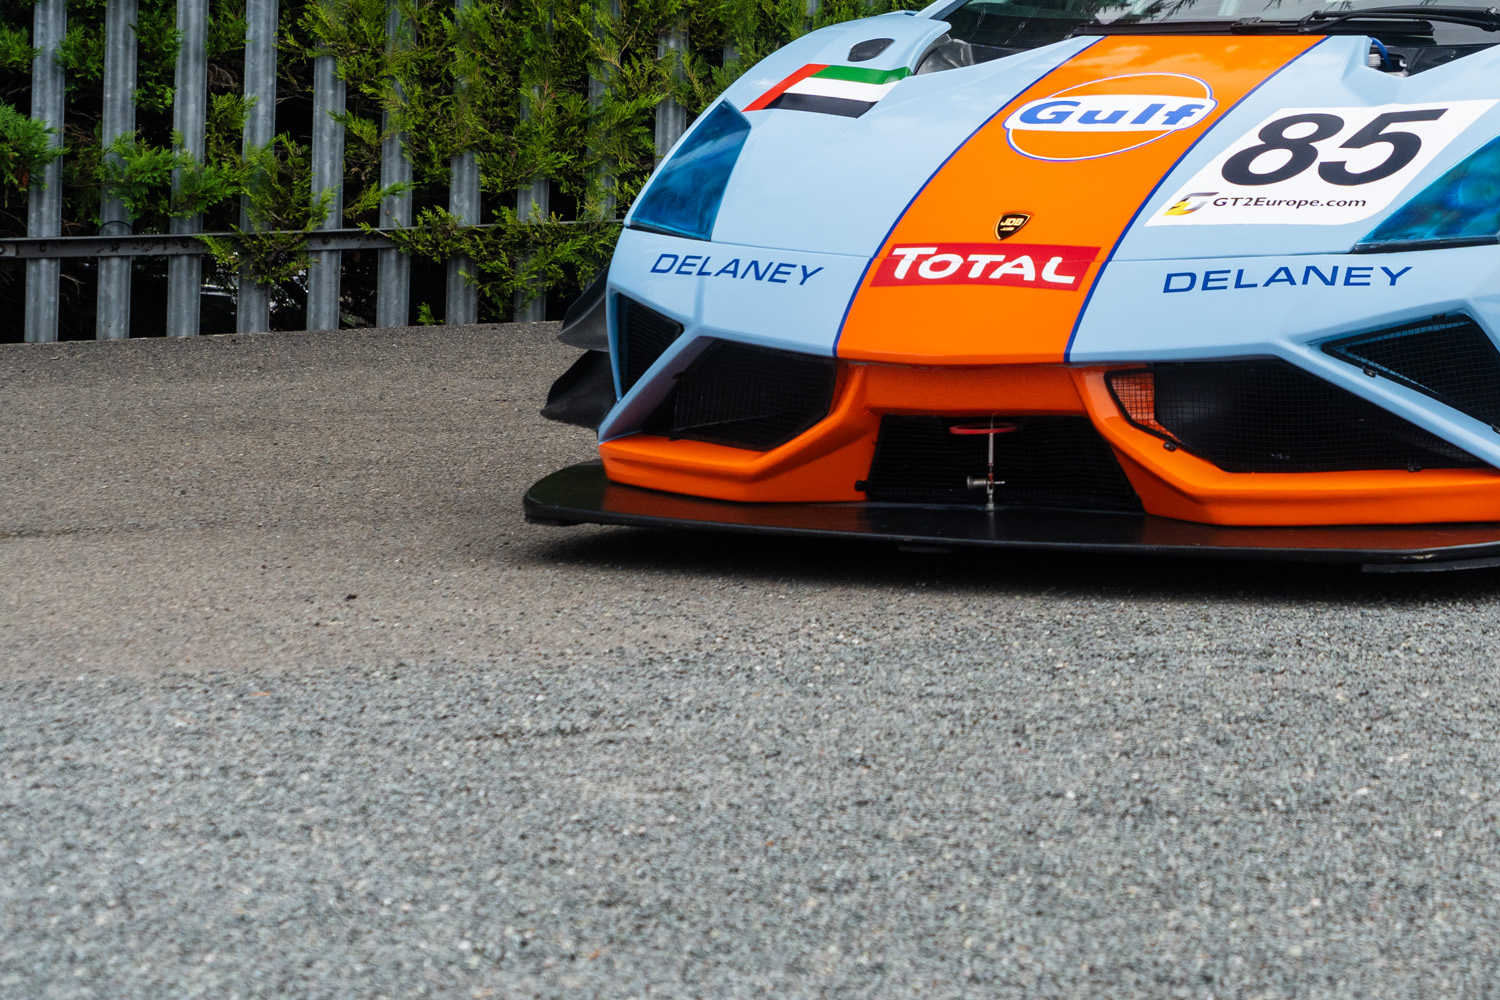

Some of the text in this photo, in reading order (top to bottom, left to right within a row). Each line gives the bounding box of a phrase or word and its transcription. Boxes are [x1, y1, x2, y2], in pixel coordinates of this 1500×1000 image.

[1019, 100, 1206, 126] Gulf
[1221, 107, 1449, 187] 85
[1212, 196, 1367, 209] GT2Europe.com
[650, 253, 825, 286] DELANEY
[892, 246, 1076, 285] TOTAL
[1162, 265, 1414, 294] DELANEY
